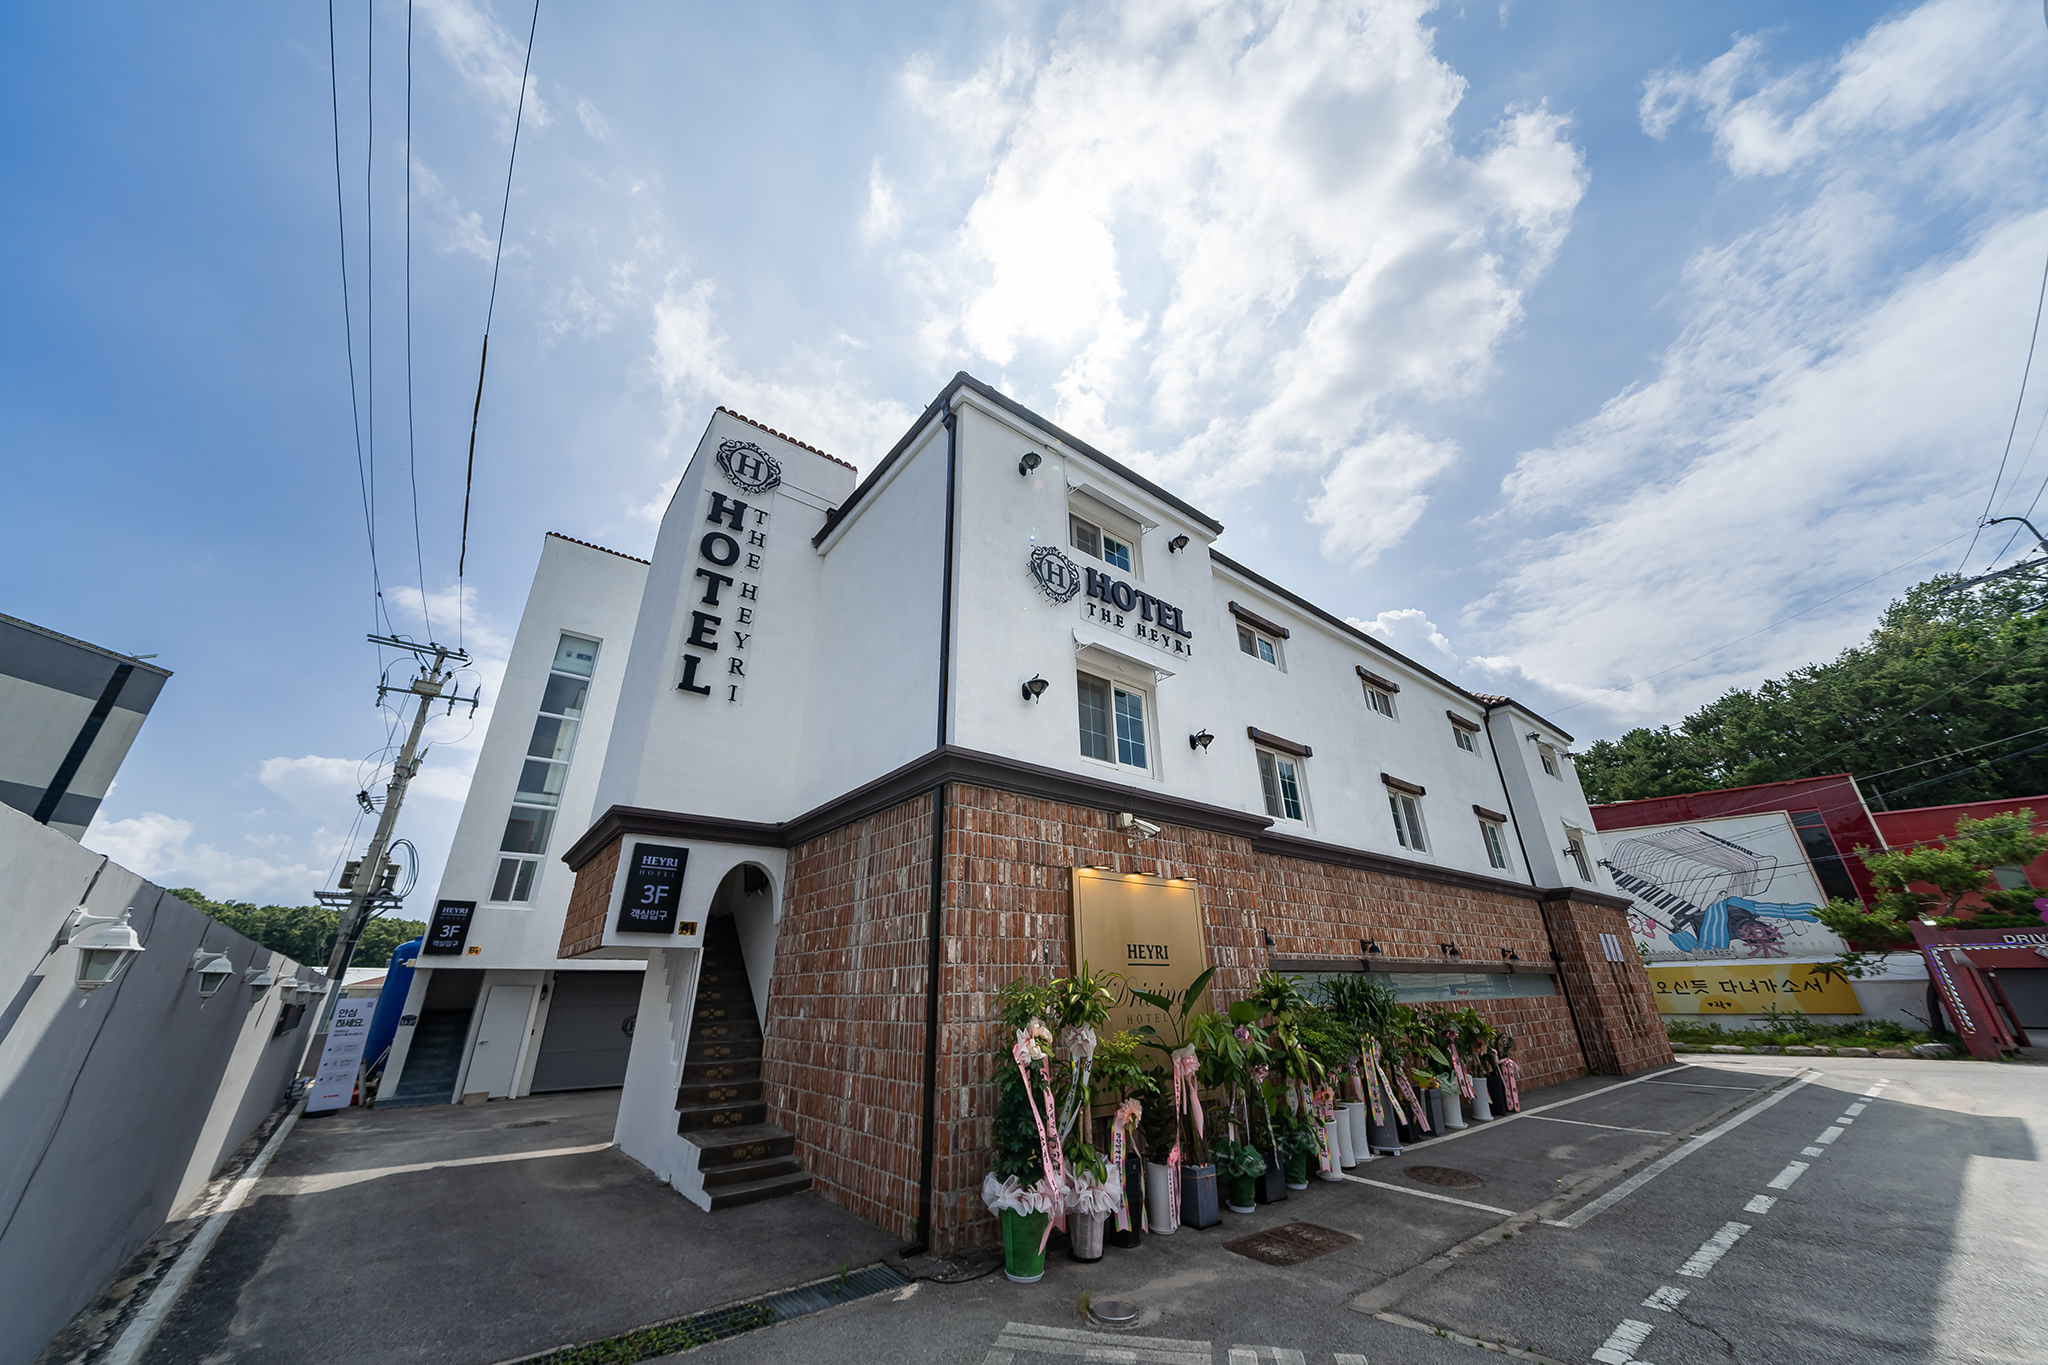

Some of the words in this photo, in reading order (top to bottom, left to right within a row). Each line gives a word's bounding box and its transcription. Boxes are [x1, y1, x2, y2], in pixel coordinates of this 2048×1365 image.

[745, 507, 769, 571] THE
[676, 490, 748, 697] HOTEL
[1086, 566, 1192, 640] HOTEL
[1087, 602, 1125, 629] THE
[1137, 622, 1192, 657] HEYRI
[727, 581, 759, 703] HEYRI
[641, 855, 679, 867] HEYRI
[639, 869, 676, 879] HOTEL
[640, 884, 670, 904] 3F
[442, 906, 469, 914] HEYRI
[630, 908, 668, 920] 객실입구
[439, 924, 461, 938] 3F
[2002, 933, 2048, 945] DRIV
[1127, 944, 1169, 960] HEYRI
[1656, 979, 1710, 995] 오신듯
[1718, 978, 1824, 994] 다녀가소서
[338, 1008, 358, 1018] 안심
[1127, 1013, 1169, 1025] HOTEL
